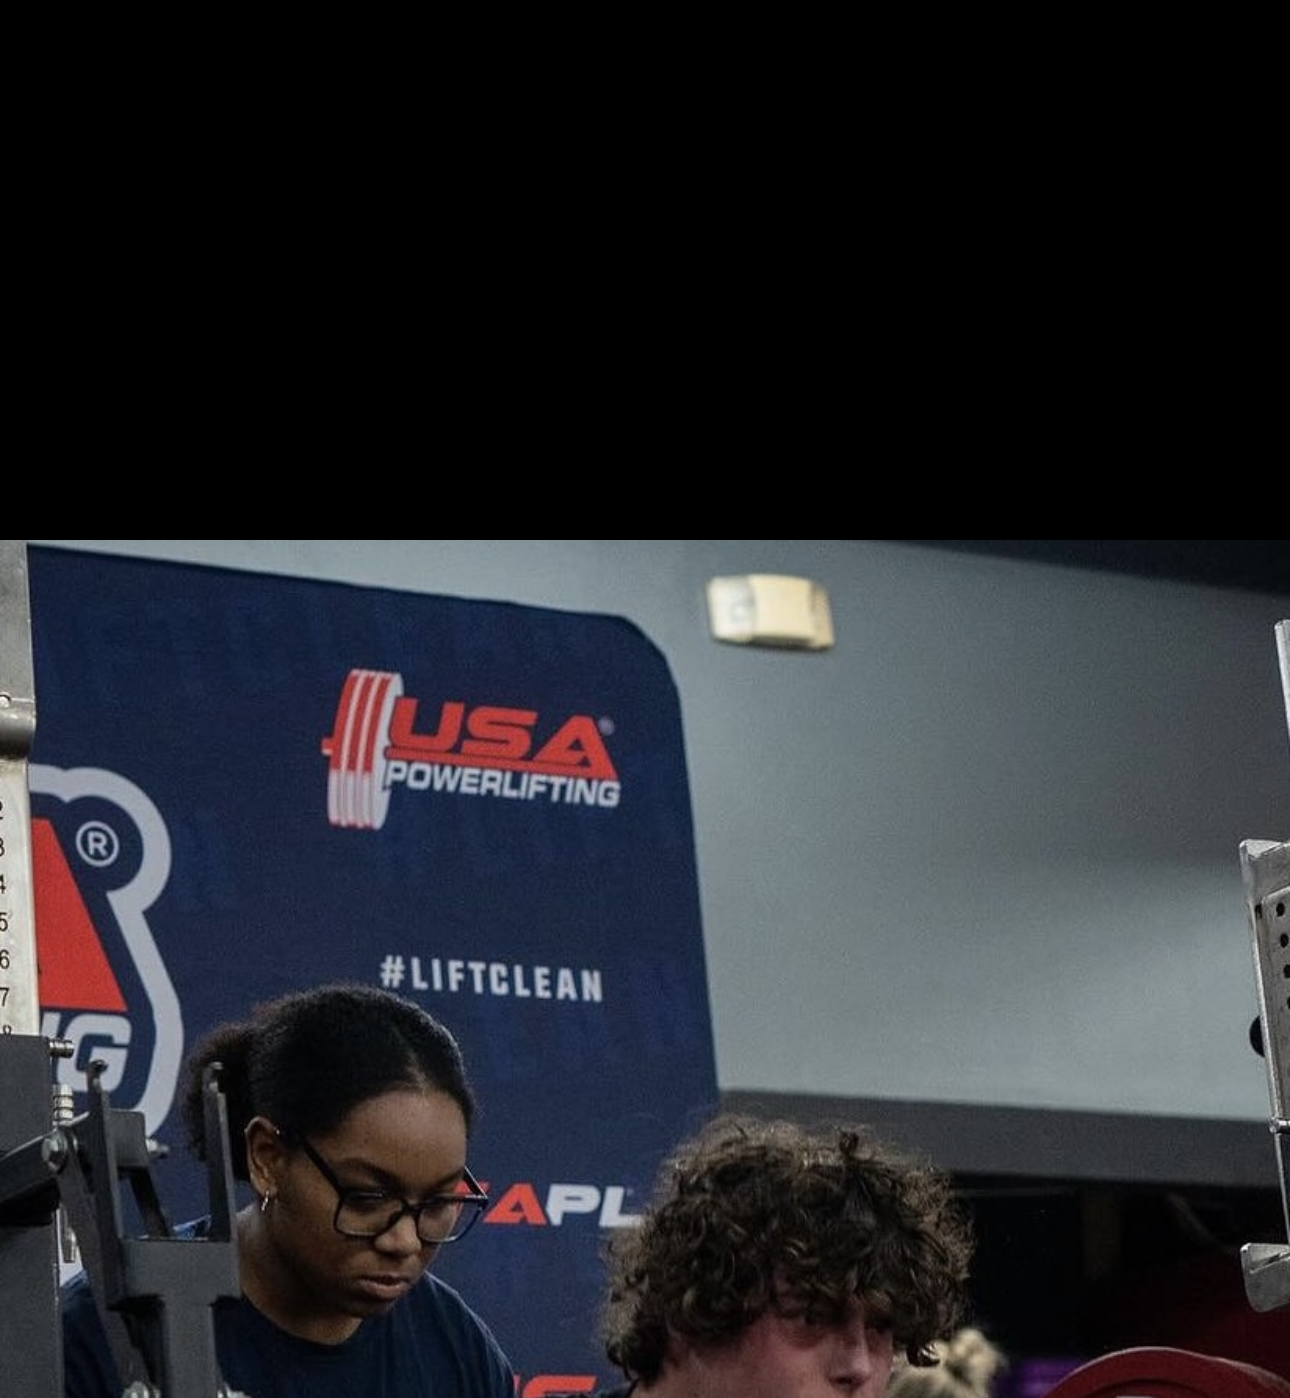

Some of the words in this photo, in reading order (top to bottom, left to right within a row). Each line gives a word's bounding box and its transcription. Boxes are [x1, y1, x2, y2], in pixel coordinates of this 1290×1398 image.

[388, 696, 618, 780] USA
[386, 760, 621, 807] POWERLIFTING
[0, 949, 10, 970] 6
[380, 954, 603, 1002] #LIFTCLEAN
[0, 987, 10, 1007] 7
